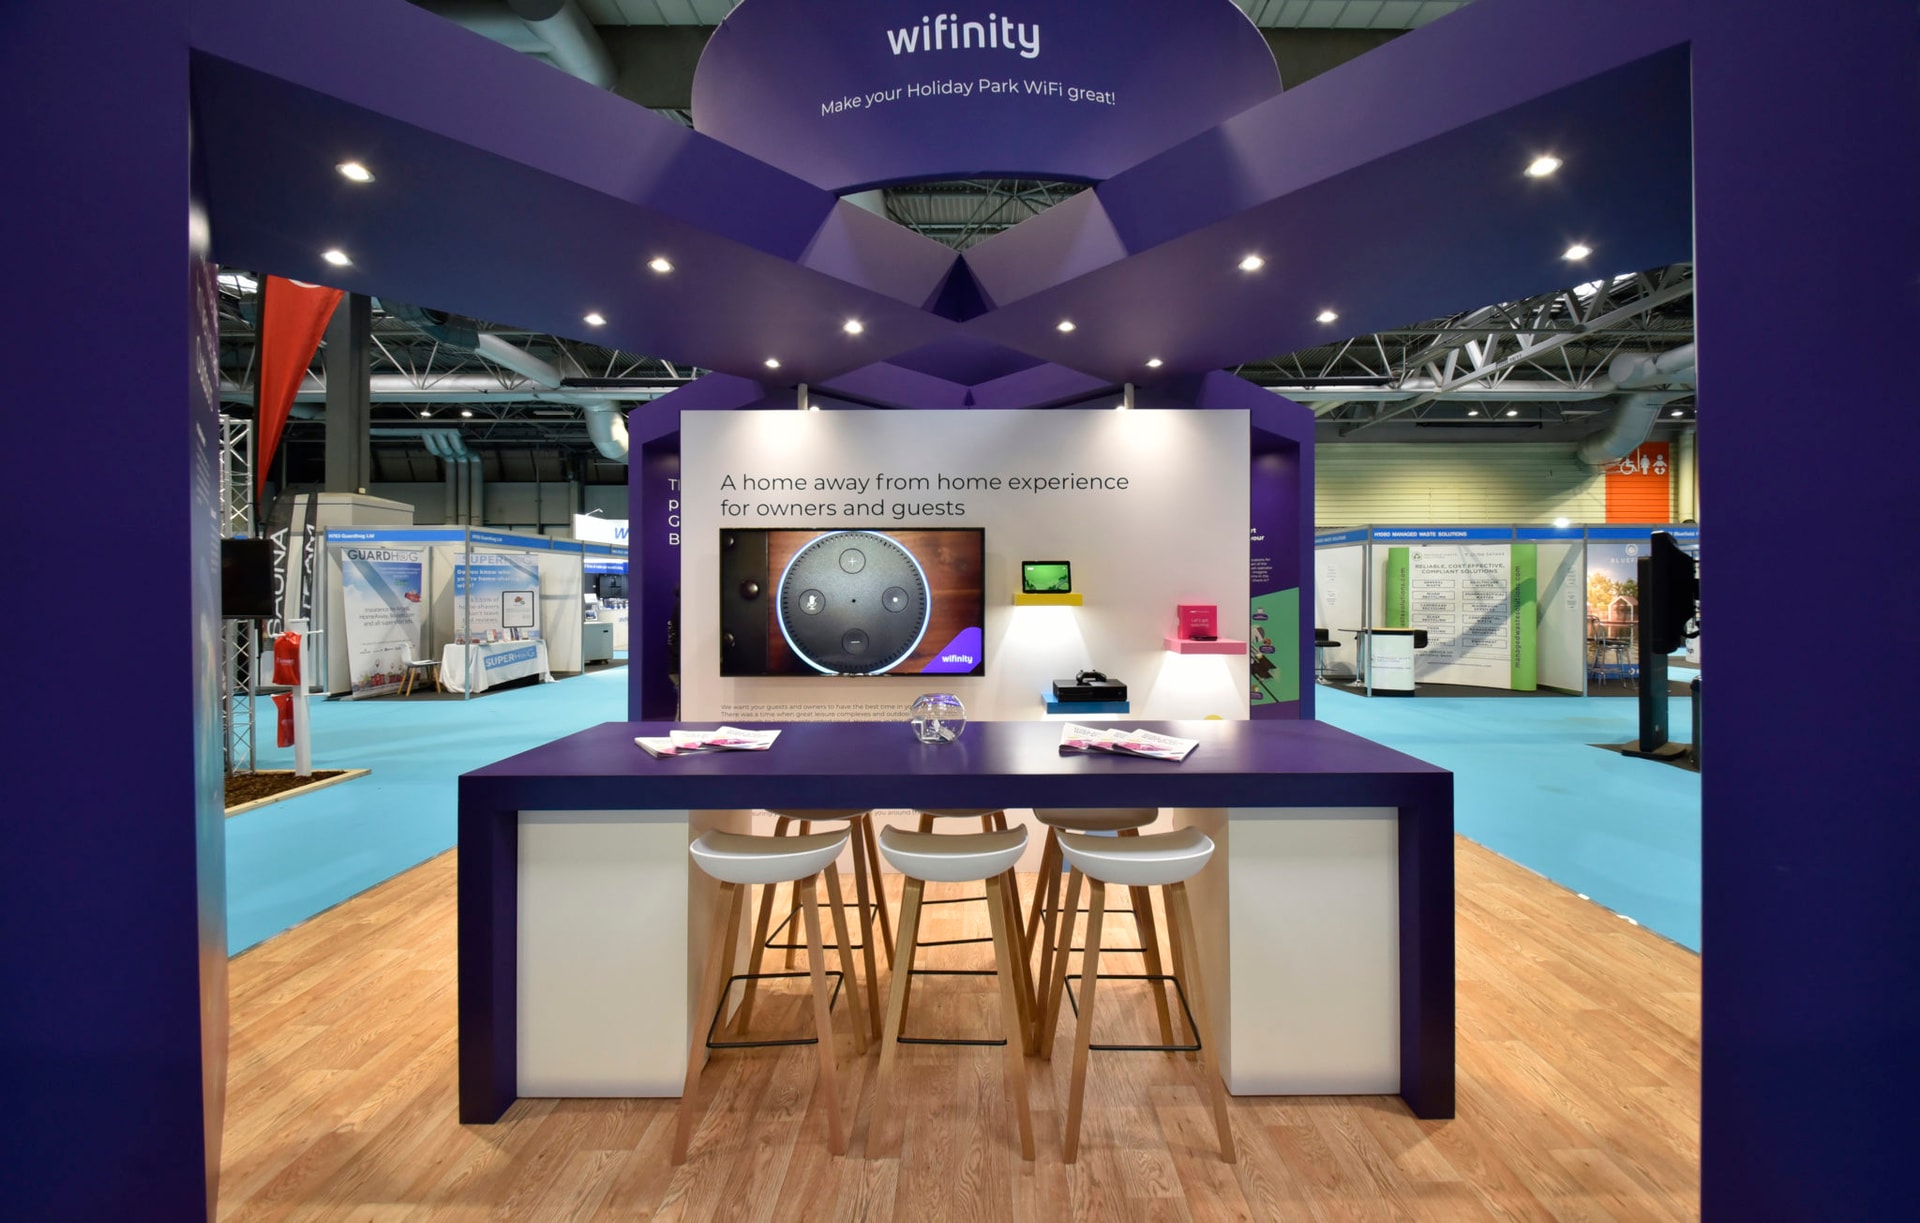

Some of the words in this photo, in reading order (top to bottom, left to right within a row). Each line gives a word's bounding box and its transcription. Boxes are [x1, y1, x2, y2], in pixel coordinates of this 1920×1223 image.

[887, 13, 1039, 58] wifinity
[821, 96, 862, 116] Make
[865, 87, 902, 108] your
[907, 79, 974, 99] Holiday
[979, 78, 1019, 94] Park
[1024, 80, 1062, 96] WiFi
[1067, 84, 1116, 105] great!
[721, 474, 736, 490] A
[744, 473, 806, 490] home
[815, 477, 870, 495] away
[876, 472, 930, 490] from
[938, 473, 1001, 490] home
[1009, 473, 1129, 495] experience
[721, 499, 749, 516] for
[757, 503, 836, 516] owners
[844, 499, 884, 516] and
[892, 501, 965, 521] guests
[267, 527, 289, 639] SAUNA
[942, 654, 973, 664] wifinity
